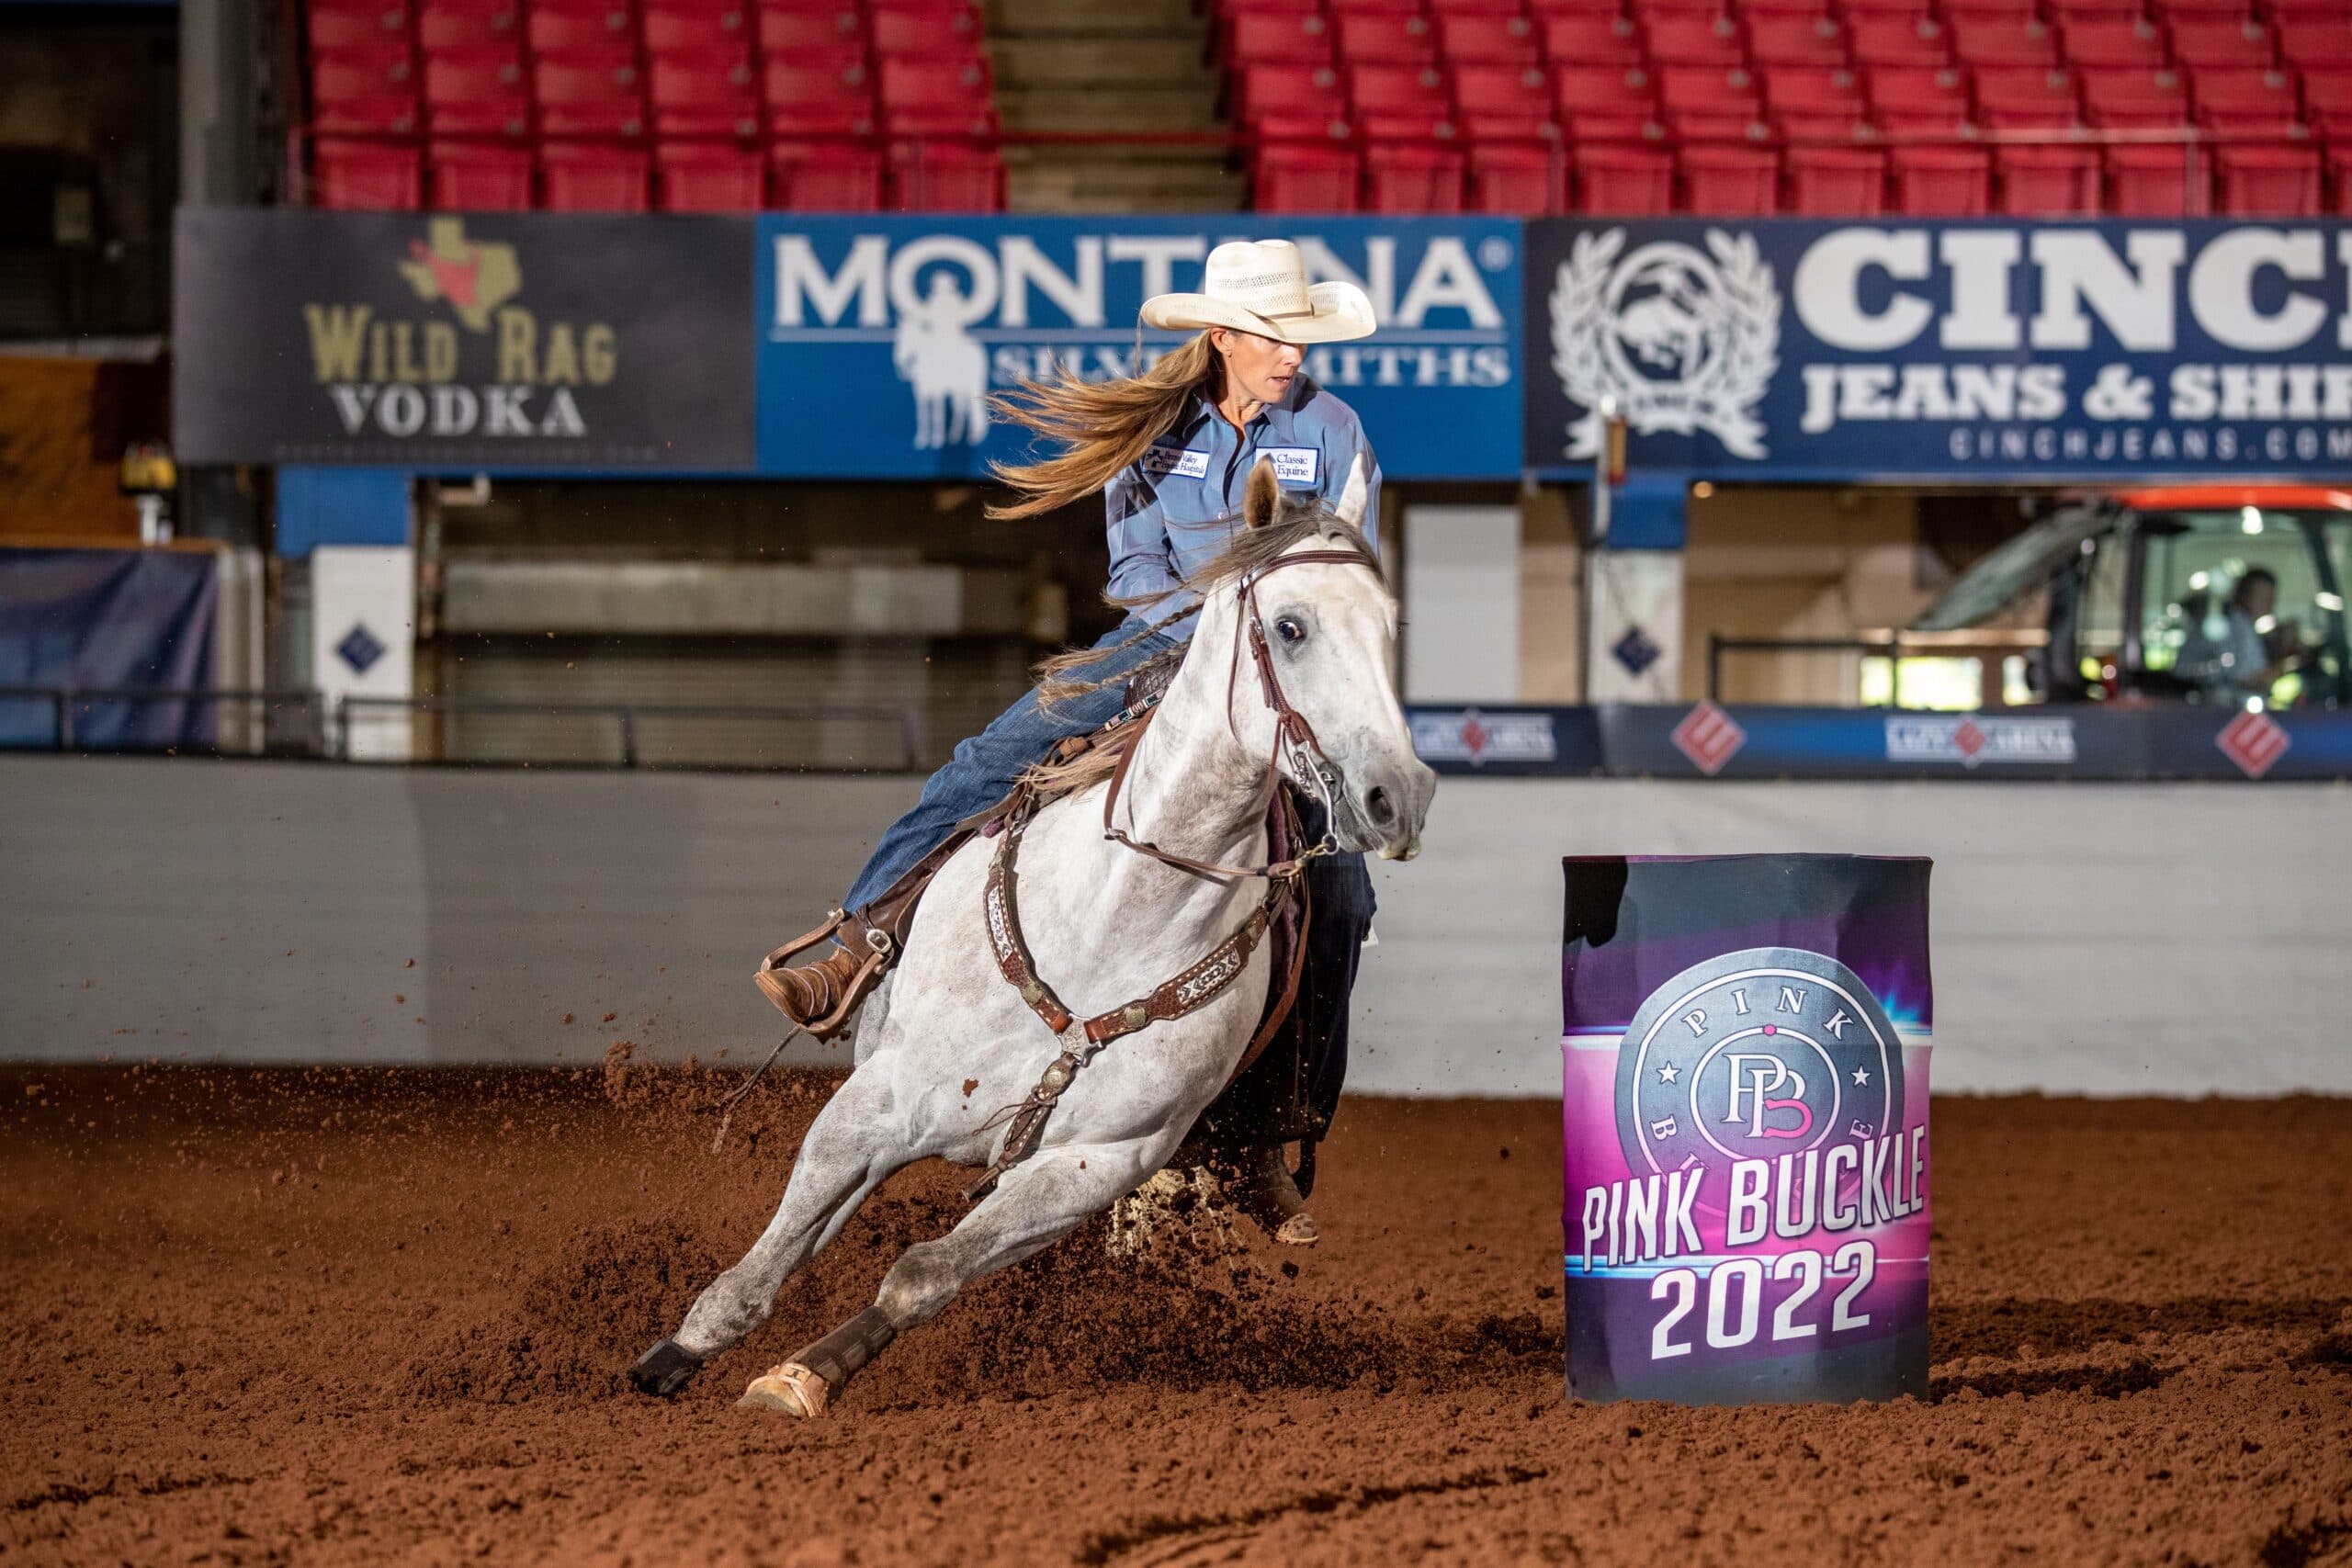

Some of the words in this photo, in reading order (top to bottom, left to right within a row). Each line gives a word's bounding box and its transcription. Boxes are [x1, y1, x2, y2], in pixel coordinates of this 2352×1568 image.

[774, 233, 1505, 330] MONTNA
[1793, 227, 2352, 352] CINC
[331, 384, 588, 437] VODKA
[1802, 365, 2066, 434] JEANS
[2083, 364, 2154, 420] &
[1277, 453, 1307, 464] Classic
[1278, 464, 1308, 477] Equine
[1682, 985, 1855, 1042] PINK
[1581, 1166, 1706, 1273] PINK
[1725, 1125, 1926, 1248] BUCKLE
[1650, 1240, 1877, 1361] 2022
